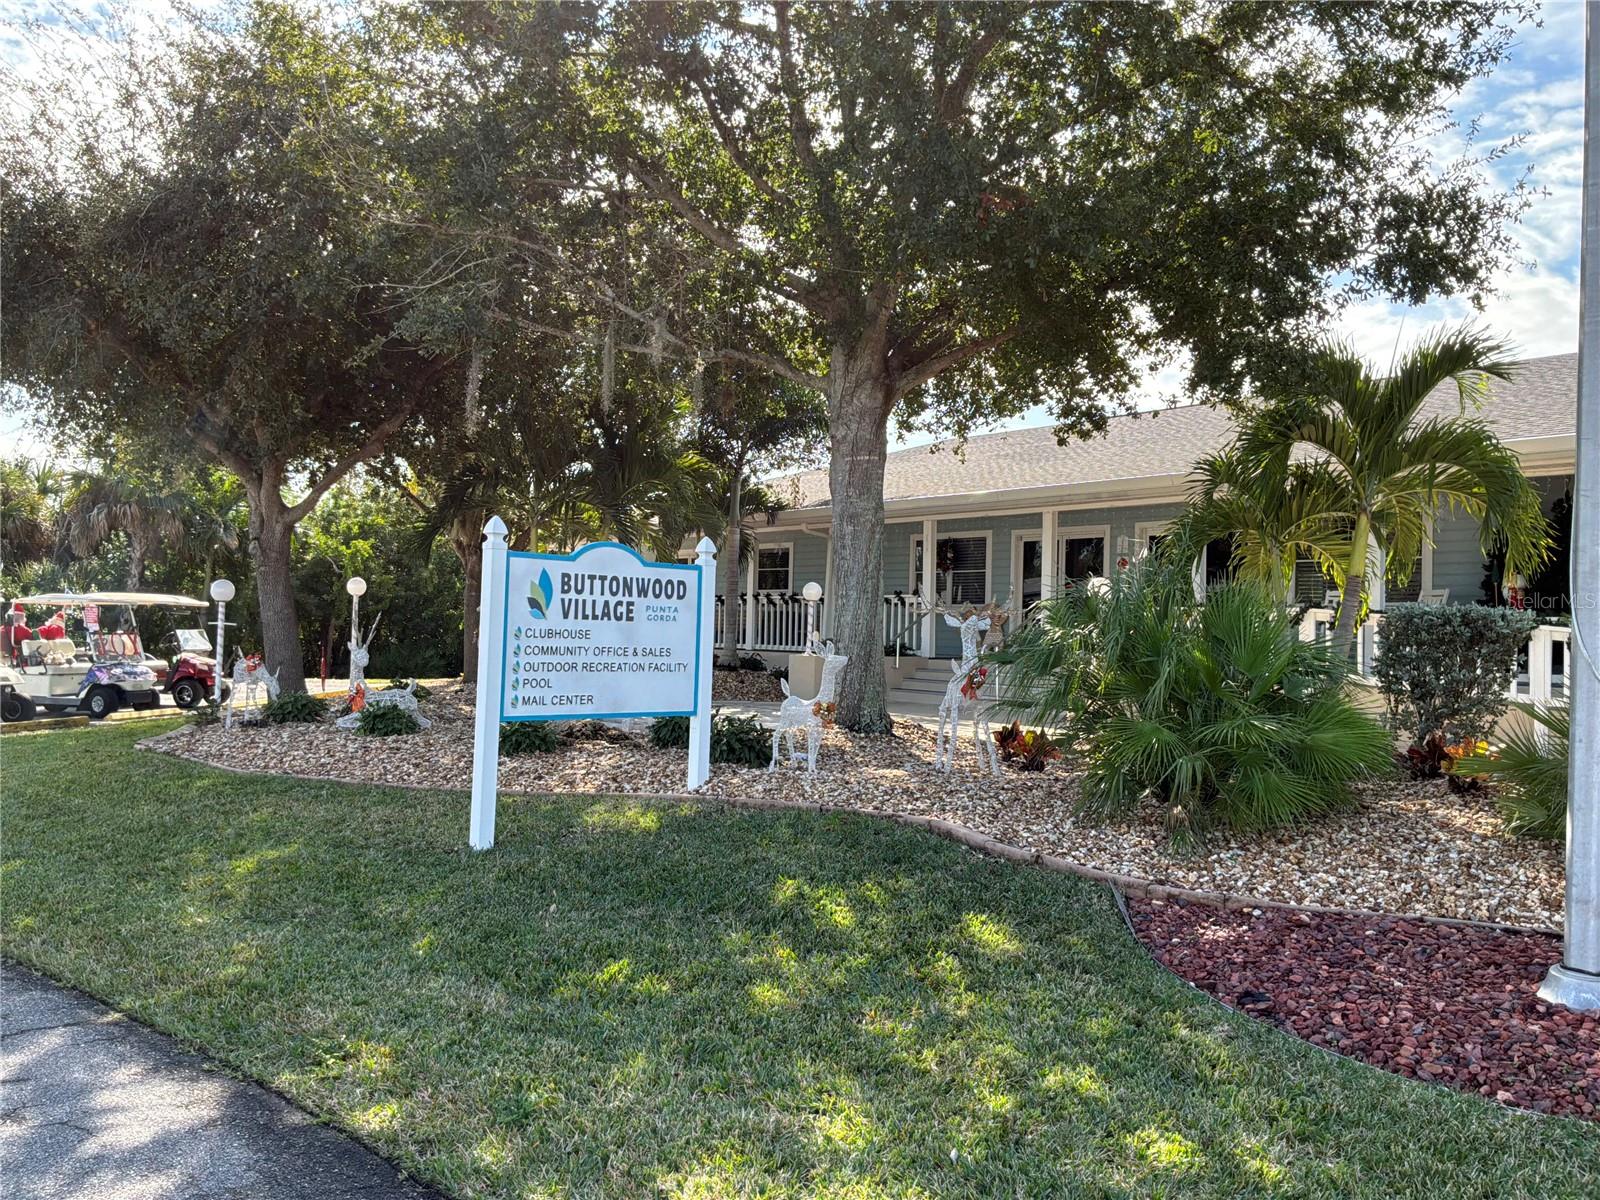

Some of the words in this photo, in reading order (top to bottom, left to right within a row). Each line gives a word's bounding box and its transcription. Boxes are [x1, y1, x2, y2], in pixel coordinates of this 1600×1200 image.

[560, 572, 687, 600] BUTTONWOOD
[561, 597, 635, 622] VILLAGE
[645, 605, 679, 614] PUNTA
[646, 614, 677, 622] GORDA
[524, 627, 591, 640] CLUBHOUSE
[523, 645, 590, 657] COMMUNITY
[593, 646, 629, 657] OFFICE
[632, 647, 638, 657] &
[641, 647, 672, 657] SALES
[523, 662, 578, 672] OUTDOOR
[581, 662, 645, 672] RECREATION
[648, 662, 689, 672] FACILITY
[523, 678, 553, 689] POOL
[521, 695, 547, 706] MAIL
[551, 694, 594, 705] CENTER
